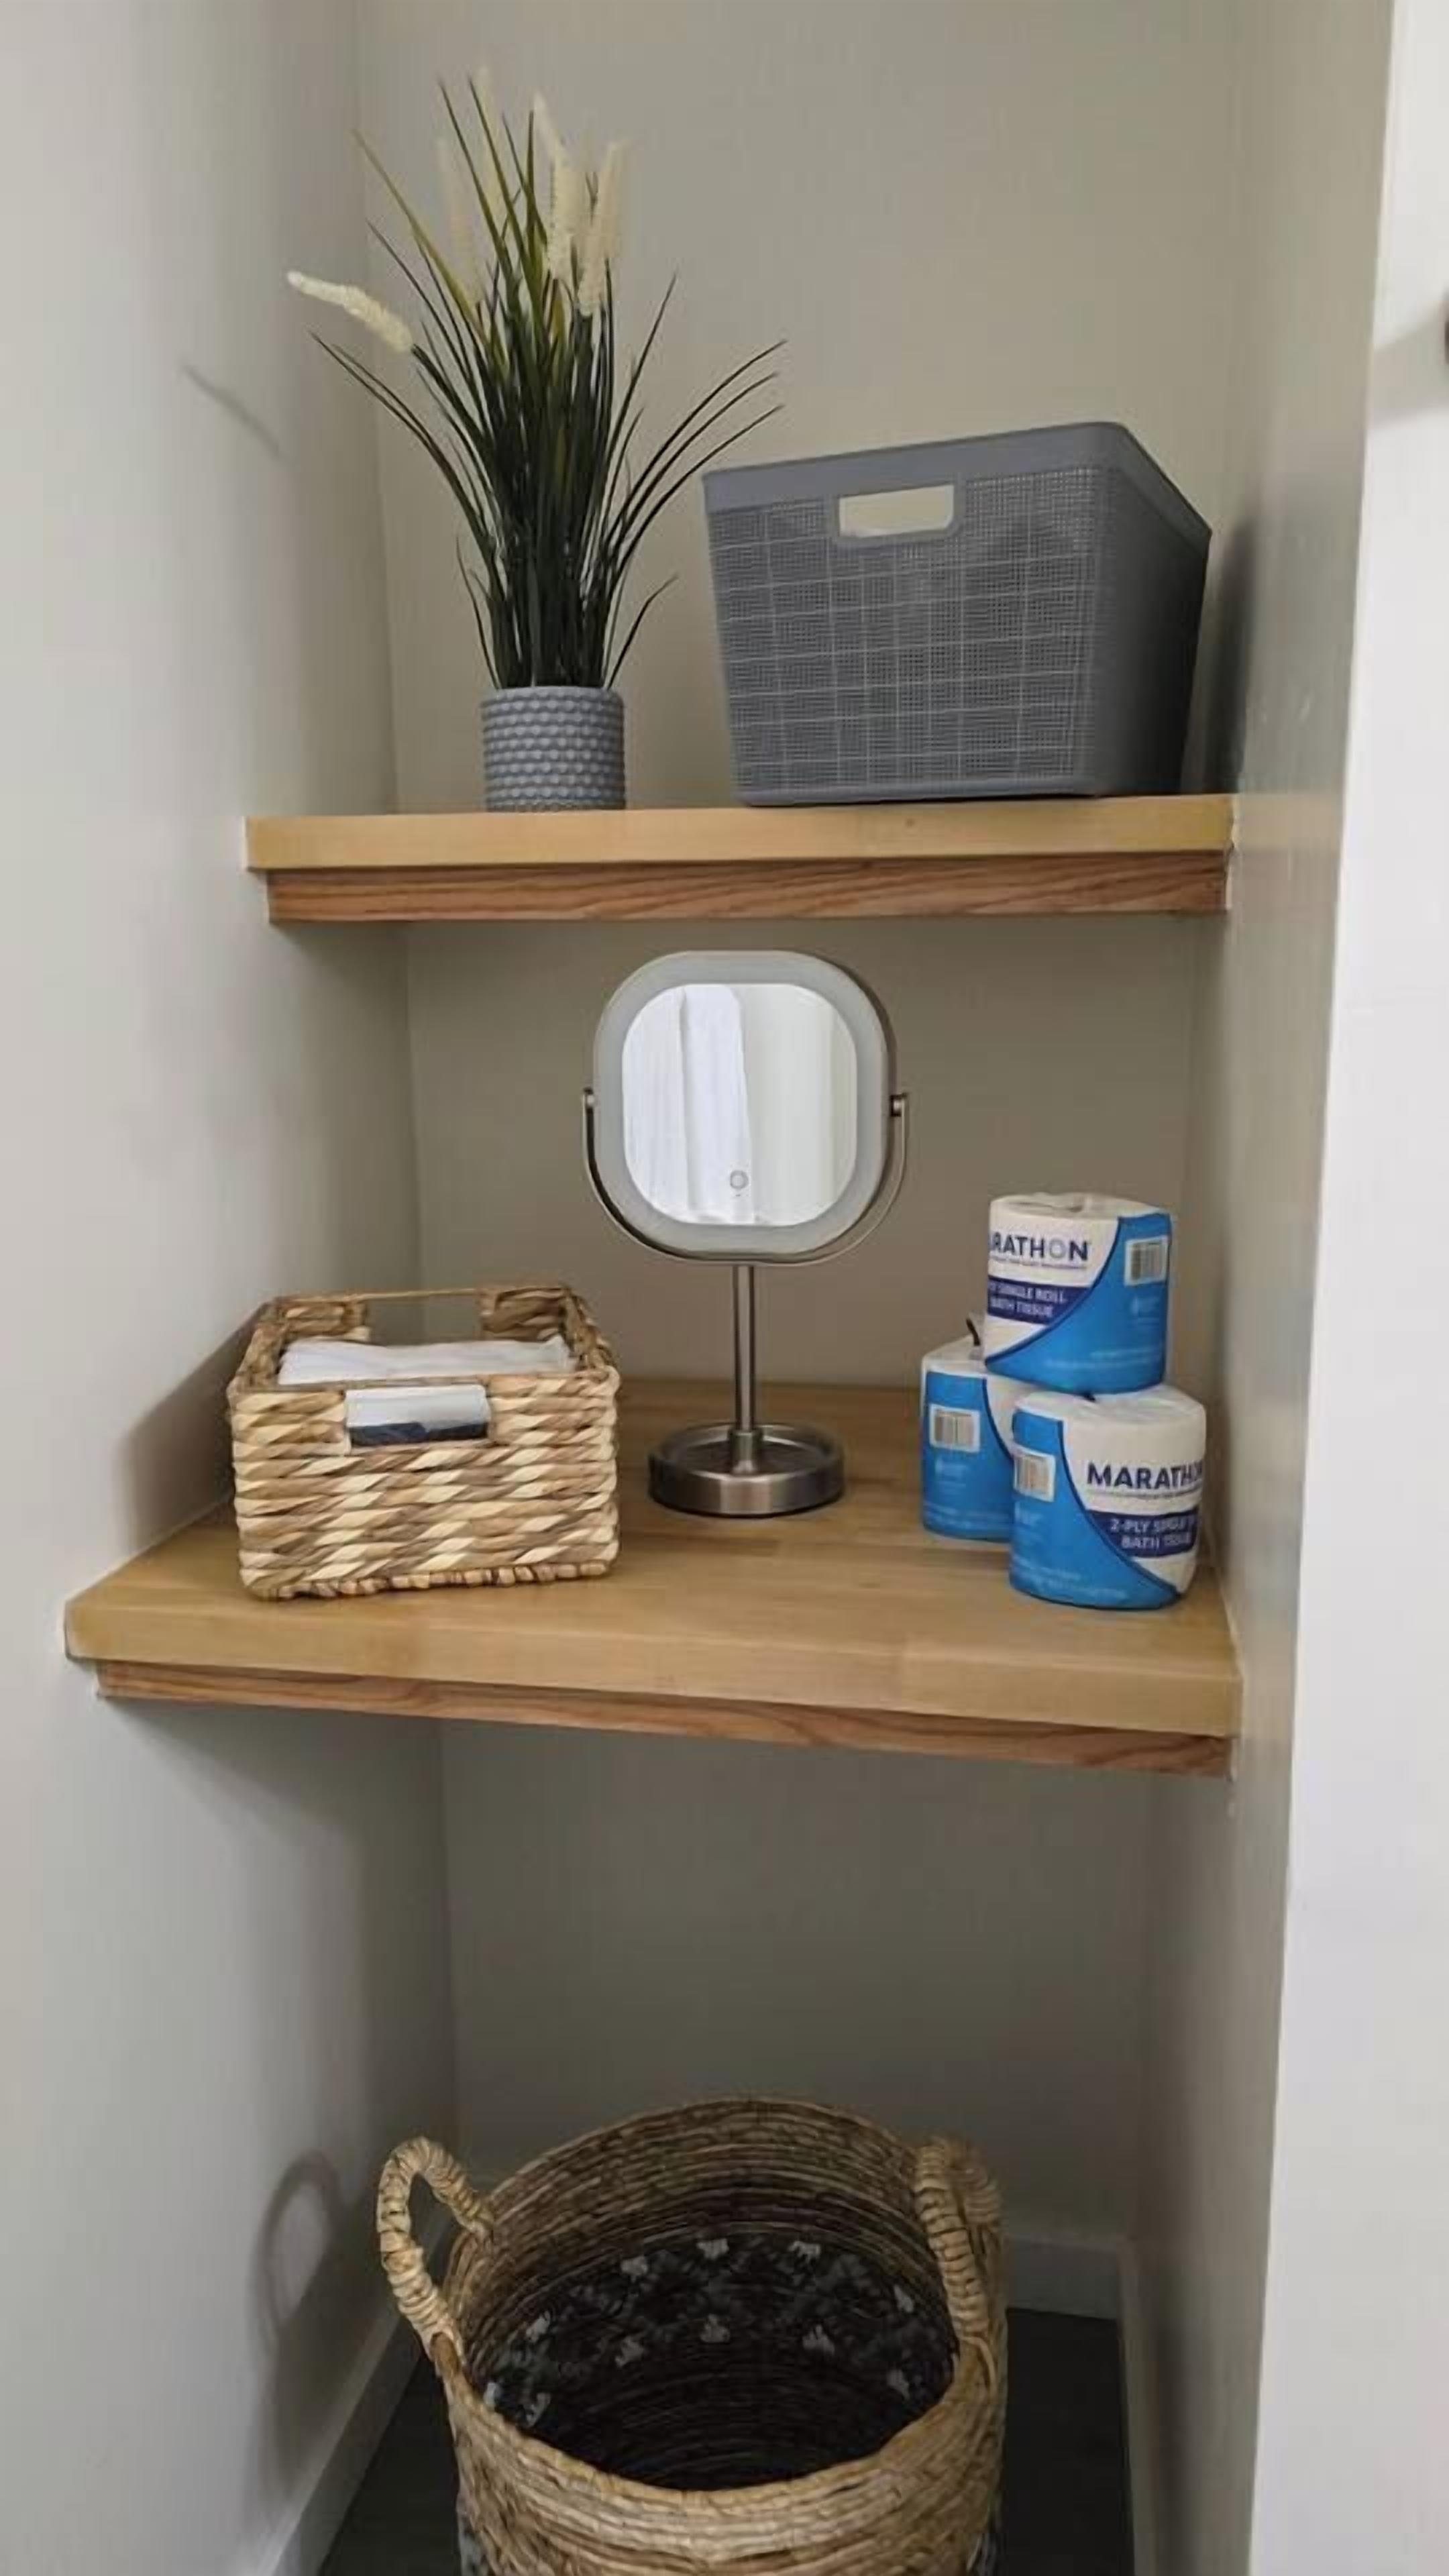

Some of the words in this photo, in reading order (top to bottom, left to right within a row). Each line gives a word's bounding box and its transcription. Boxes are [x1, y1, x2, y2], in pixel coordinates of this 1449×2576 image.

[989, 1232, 1088, 1261] RATHON
[1110, 1517, 1148, 1533] 2-PLY
[1121, 1534, 1160, 1550] BATH
